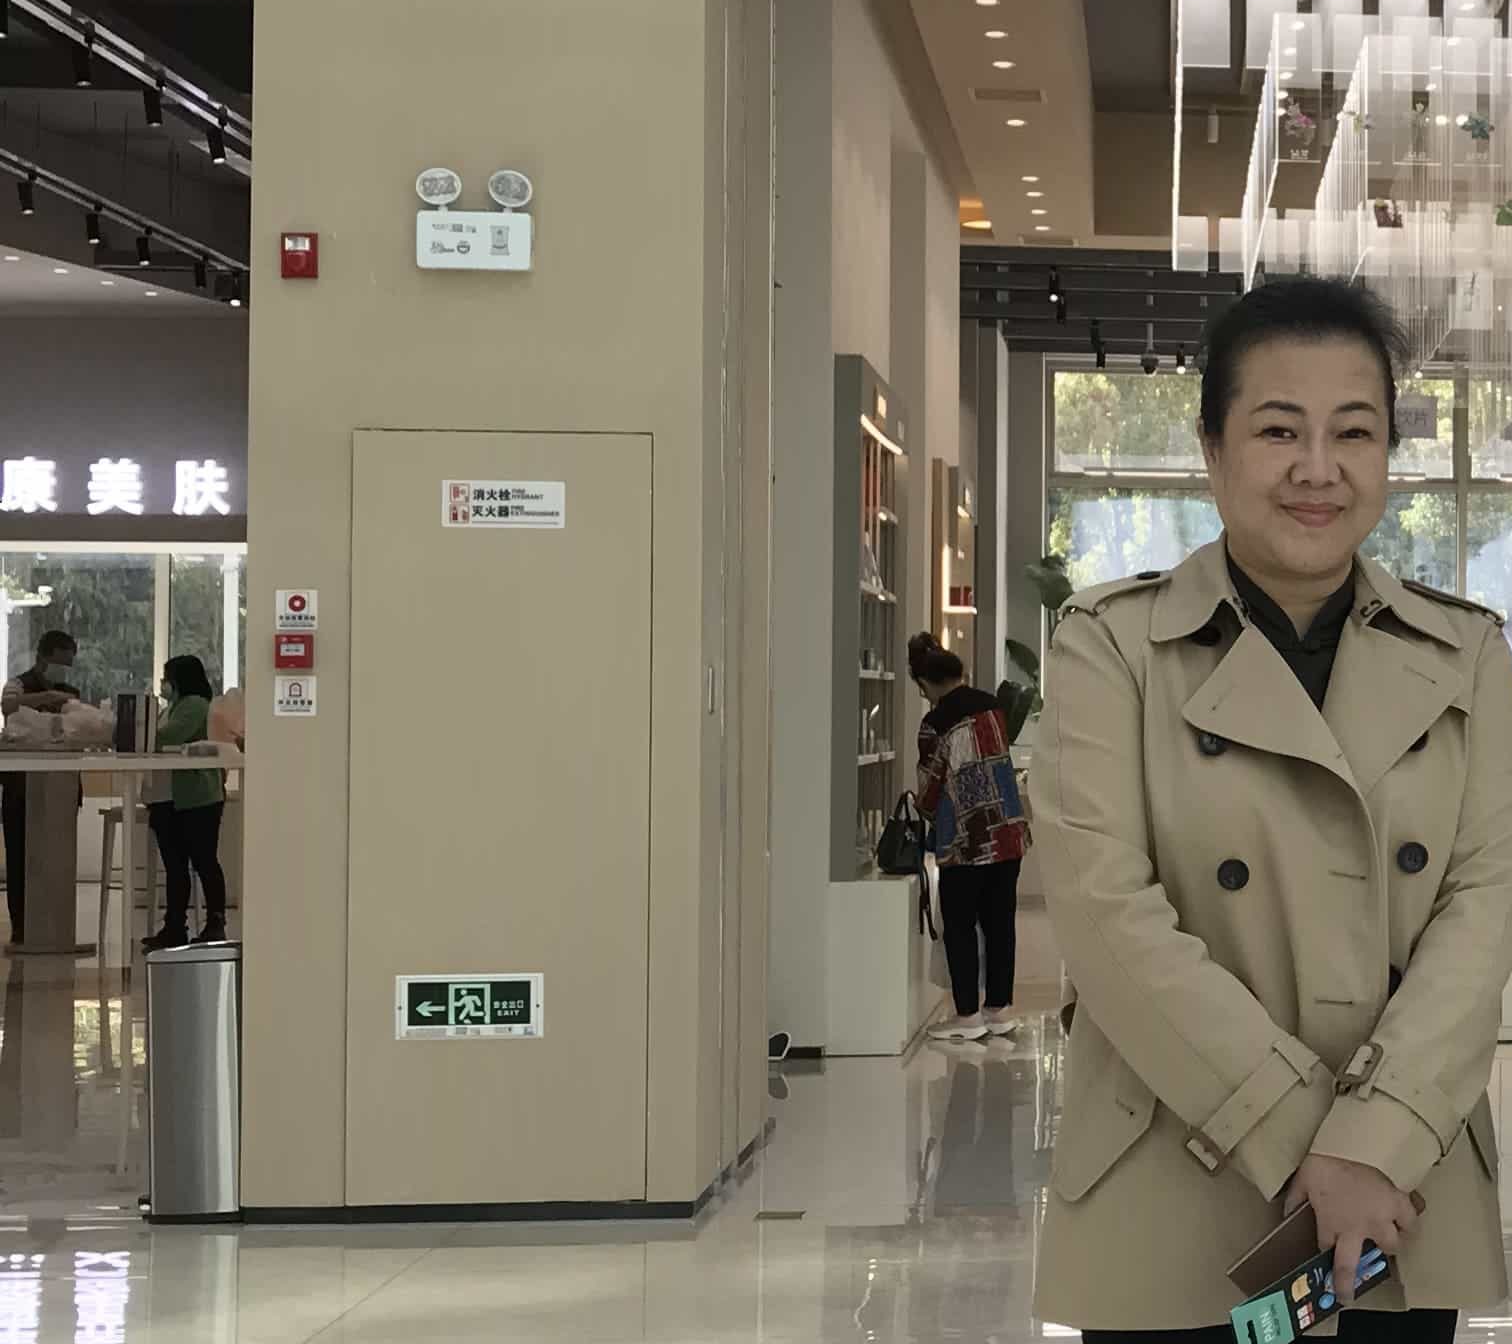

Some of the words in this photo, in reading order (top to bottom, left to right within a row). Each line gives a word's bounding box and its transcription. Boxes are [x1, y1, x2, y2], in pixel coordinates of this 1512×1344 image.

[473, 489, 511, 501] 消火栓
[472, 505, 509, 517] 灭火器
